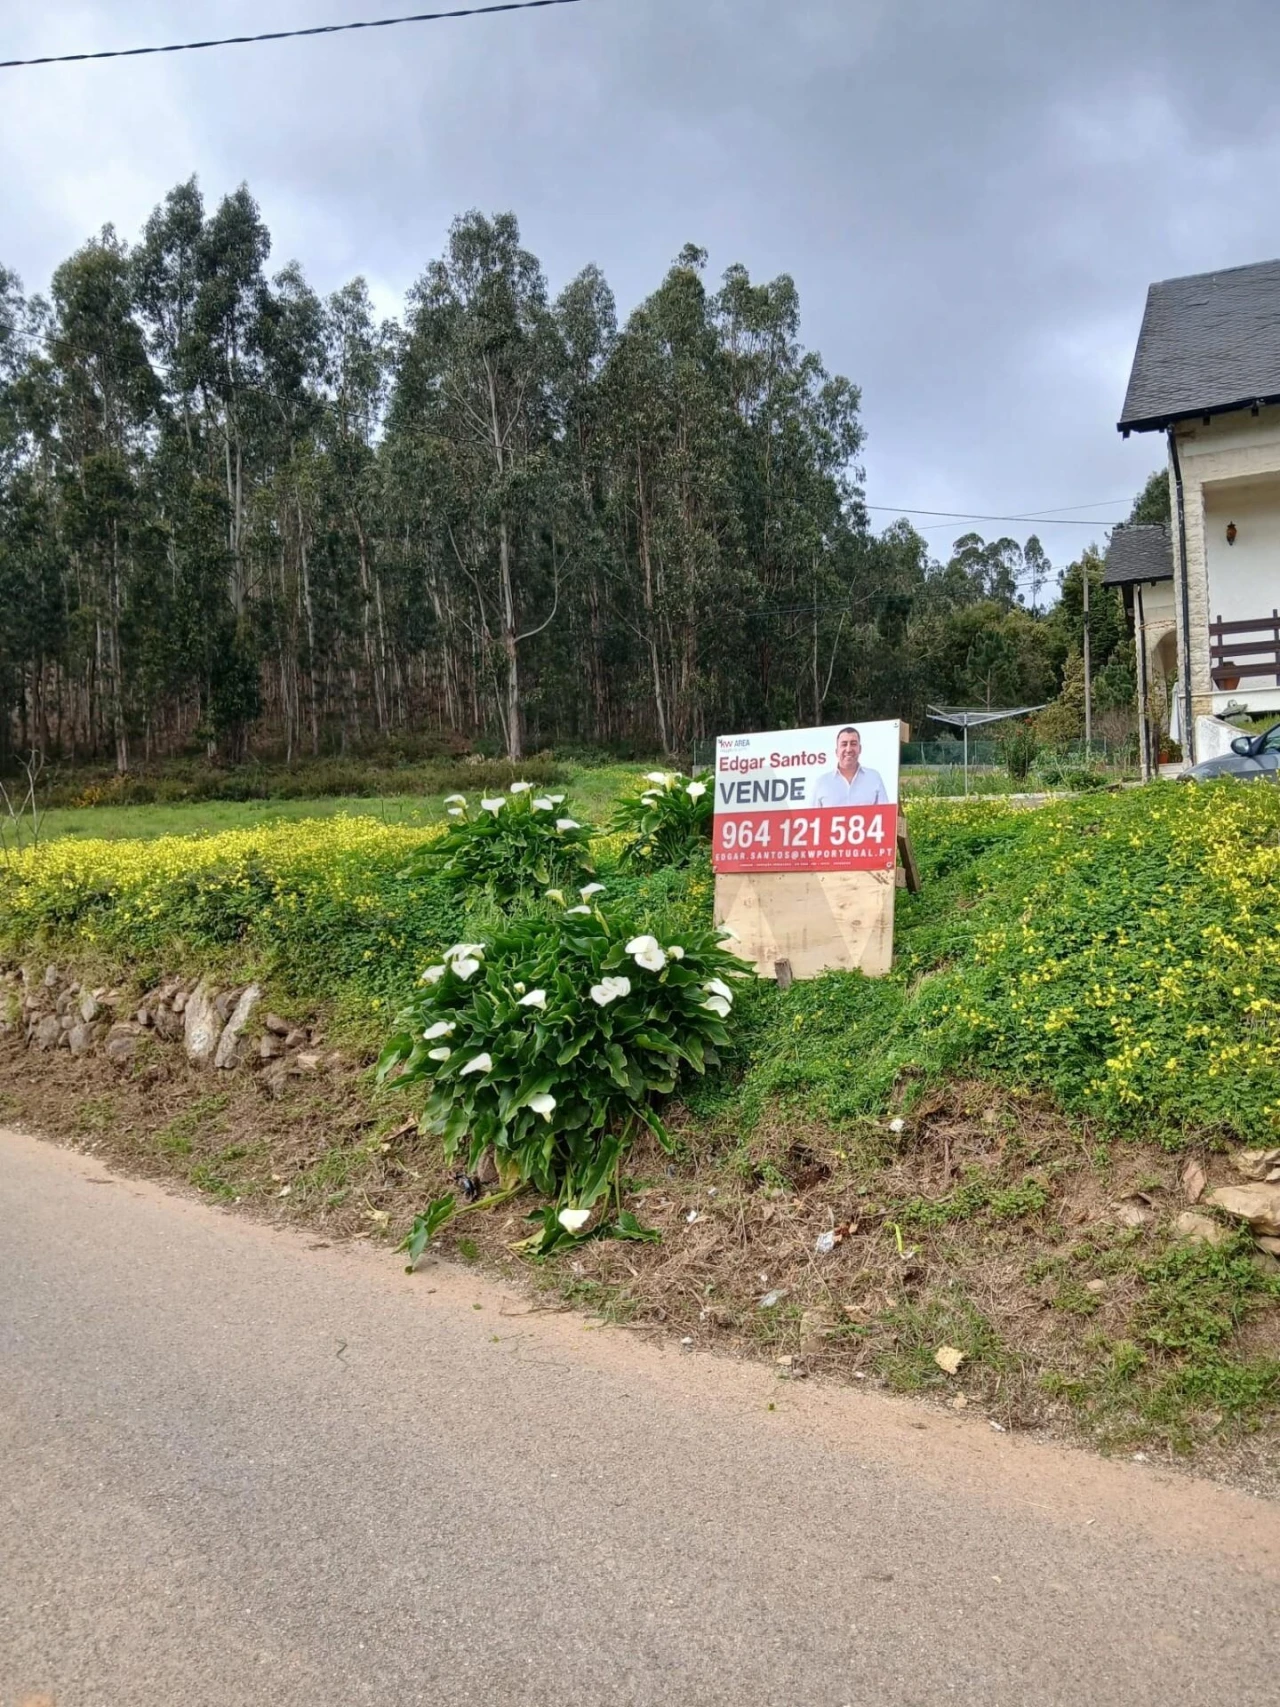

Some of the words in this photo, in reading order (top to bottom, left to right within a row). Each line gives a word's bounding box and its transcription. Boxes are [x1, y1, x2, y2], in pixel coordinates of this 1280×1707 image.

[734, 739, 750, 747] AREA
[719, 756, 765, 774] Edgar
[770, 751, 827, 768] Santos
[719, 777, 806, 804] VENDE
[722, 819, 771, 849] 964
[780, 817, 821, 847] 121
[830, 814, 885, 845] 584
[715, 848, 893, 862] EDGAR.SANTOS@KWPORTUGAL.PT
